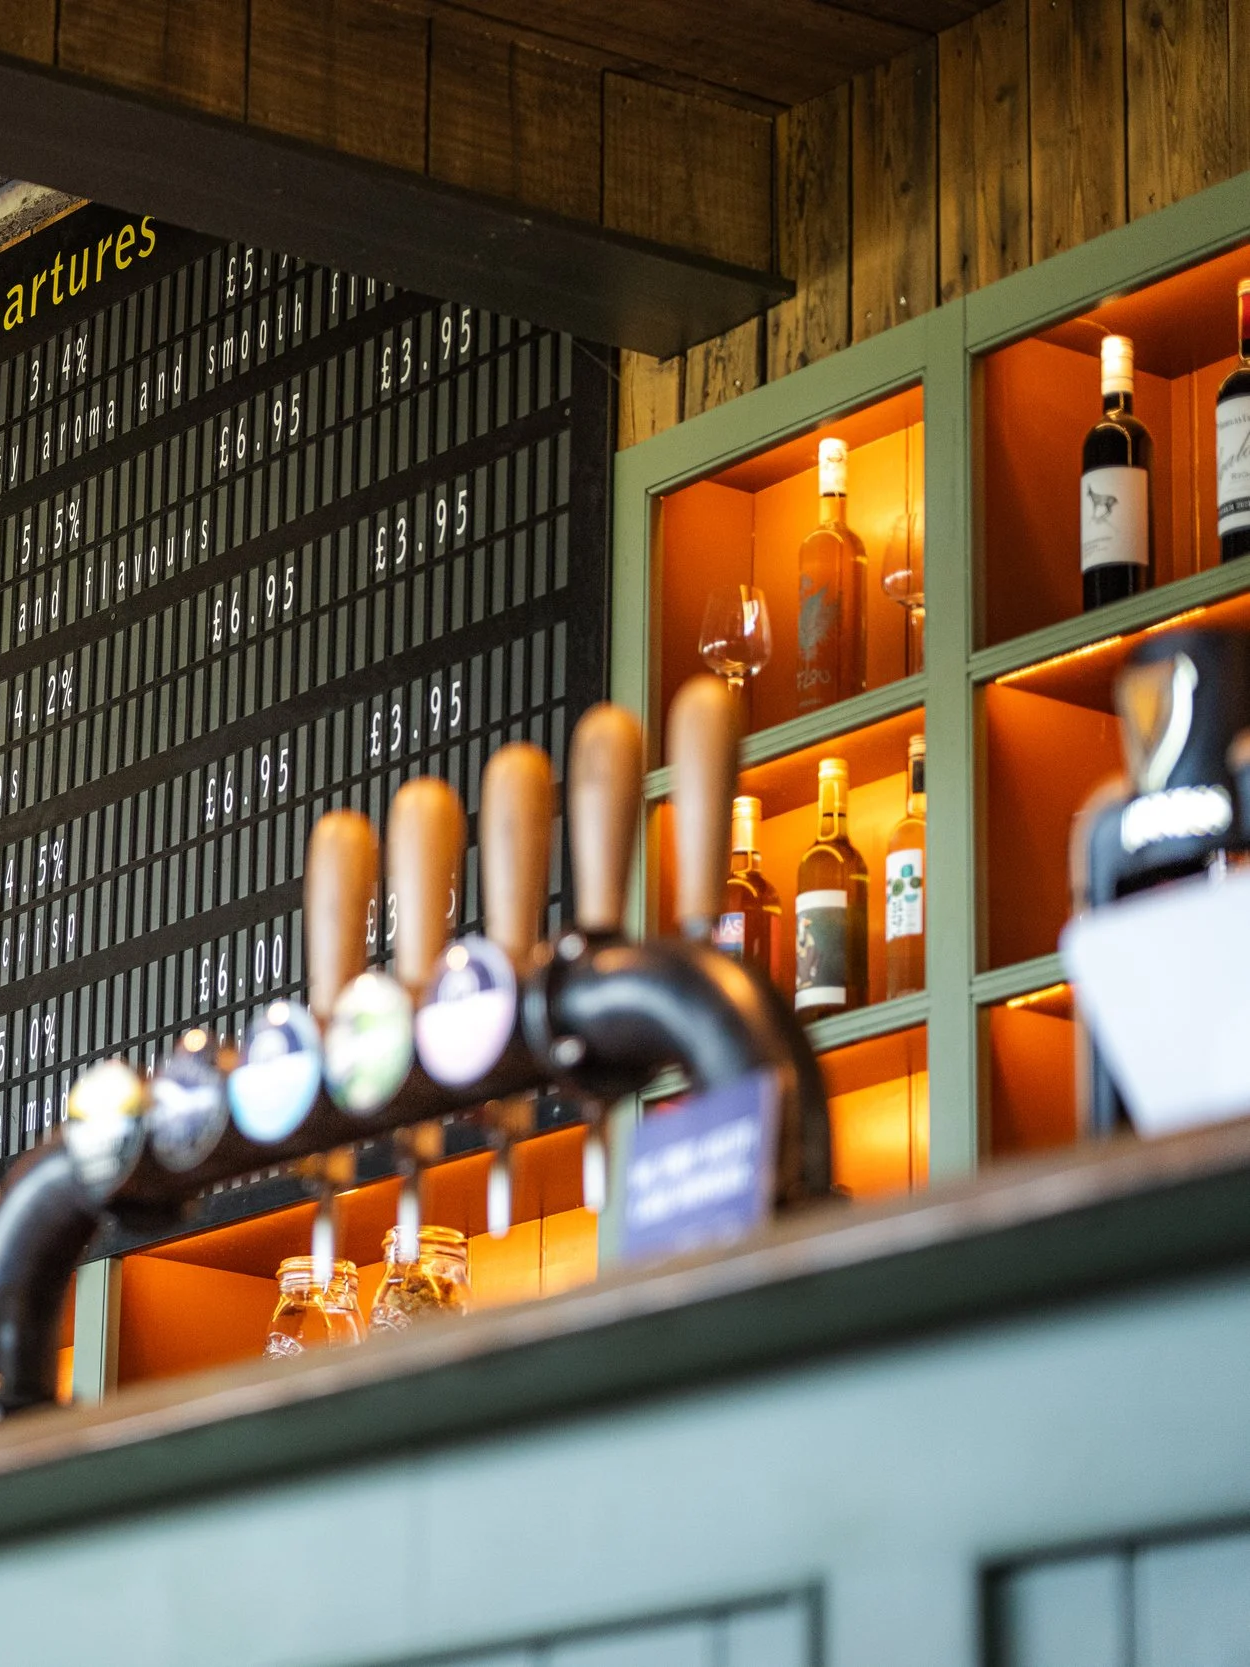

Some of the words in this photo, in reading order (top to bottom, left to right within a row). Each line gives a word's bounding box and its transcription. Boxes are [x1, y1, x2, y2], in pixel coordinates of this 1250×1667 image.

[29, 334, 88, 401] 3.4%
[225, 247, 300, 299] £5.
[41, 399, 115, 460] aroma
[138, 353, 182, 411] and
[207, 293, 302, 374] smooth
[21, 498, 80, 564] 5.5%
[218, 392, 300, 468] £6.95
[380, 308, 471, 390] £3.95
[13, 666, 73, 727] 4.2%
[212, 566, 294, 642] £6.95
[374, 489, 467, 570] £3.95
[17, 578, 60, 632] and
[84, 519, 208, 605] flavours
[4, 838, 64, 898] 4.5%
[205, 748, 288, 820] £6.95
[369, 680, 461, 756] £3.95
[1, 912, 75, 967] crisp
[198, 934, 283, 1002] £6.00
